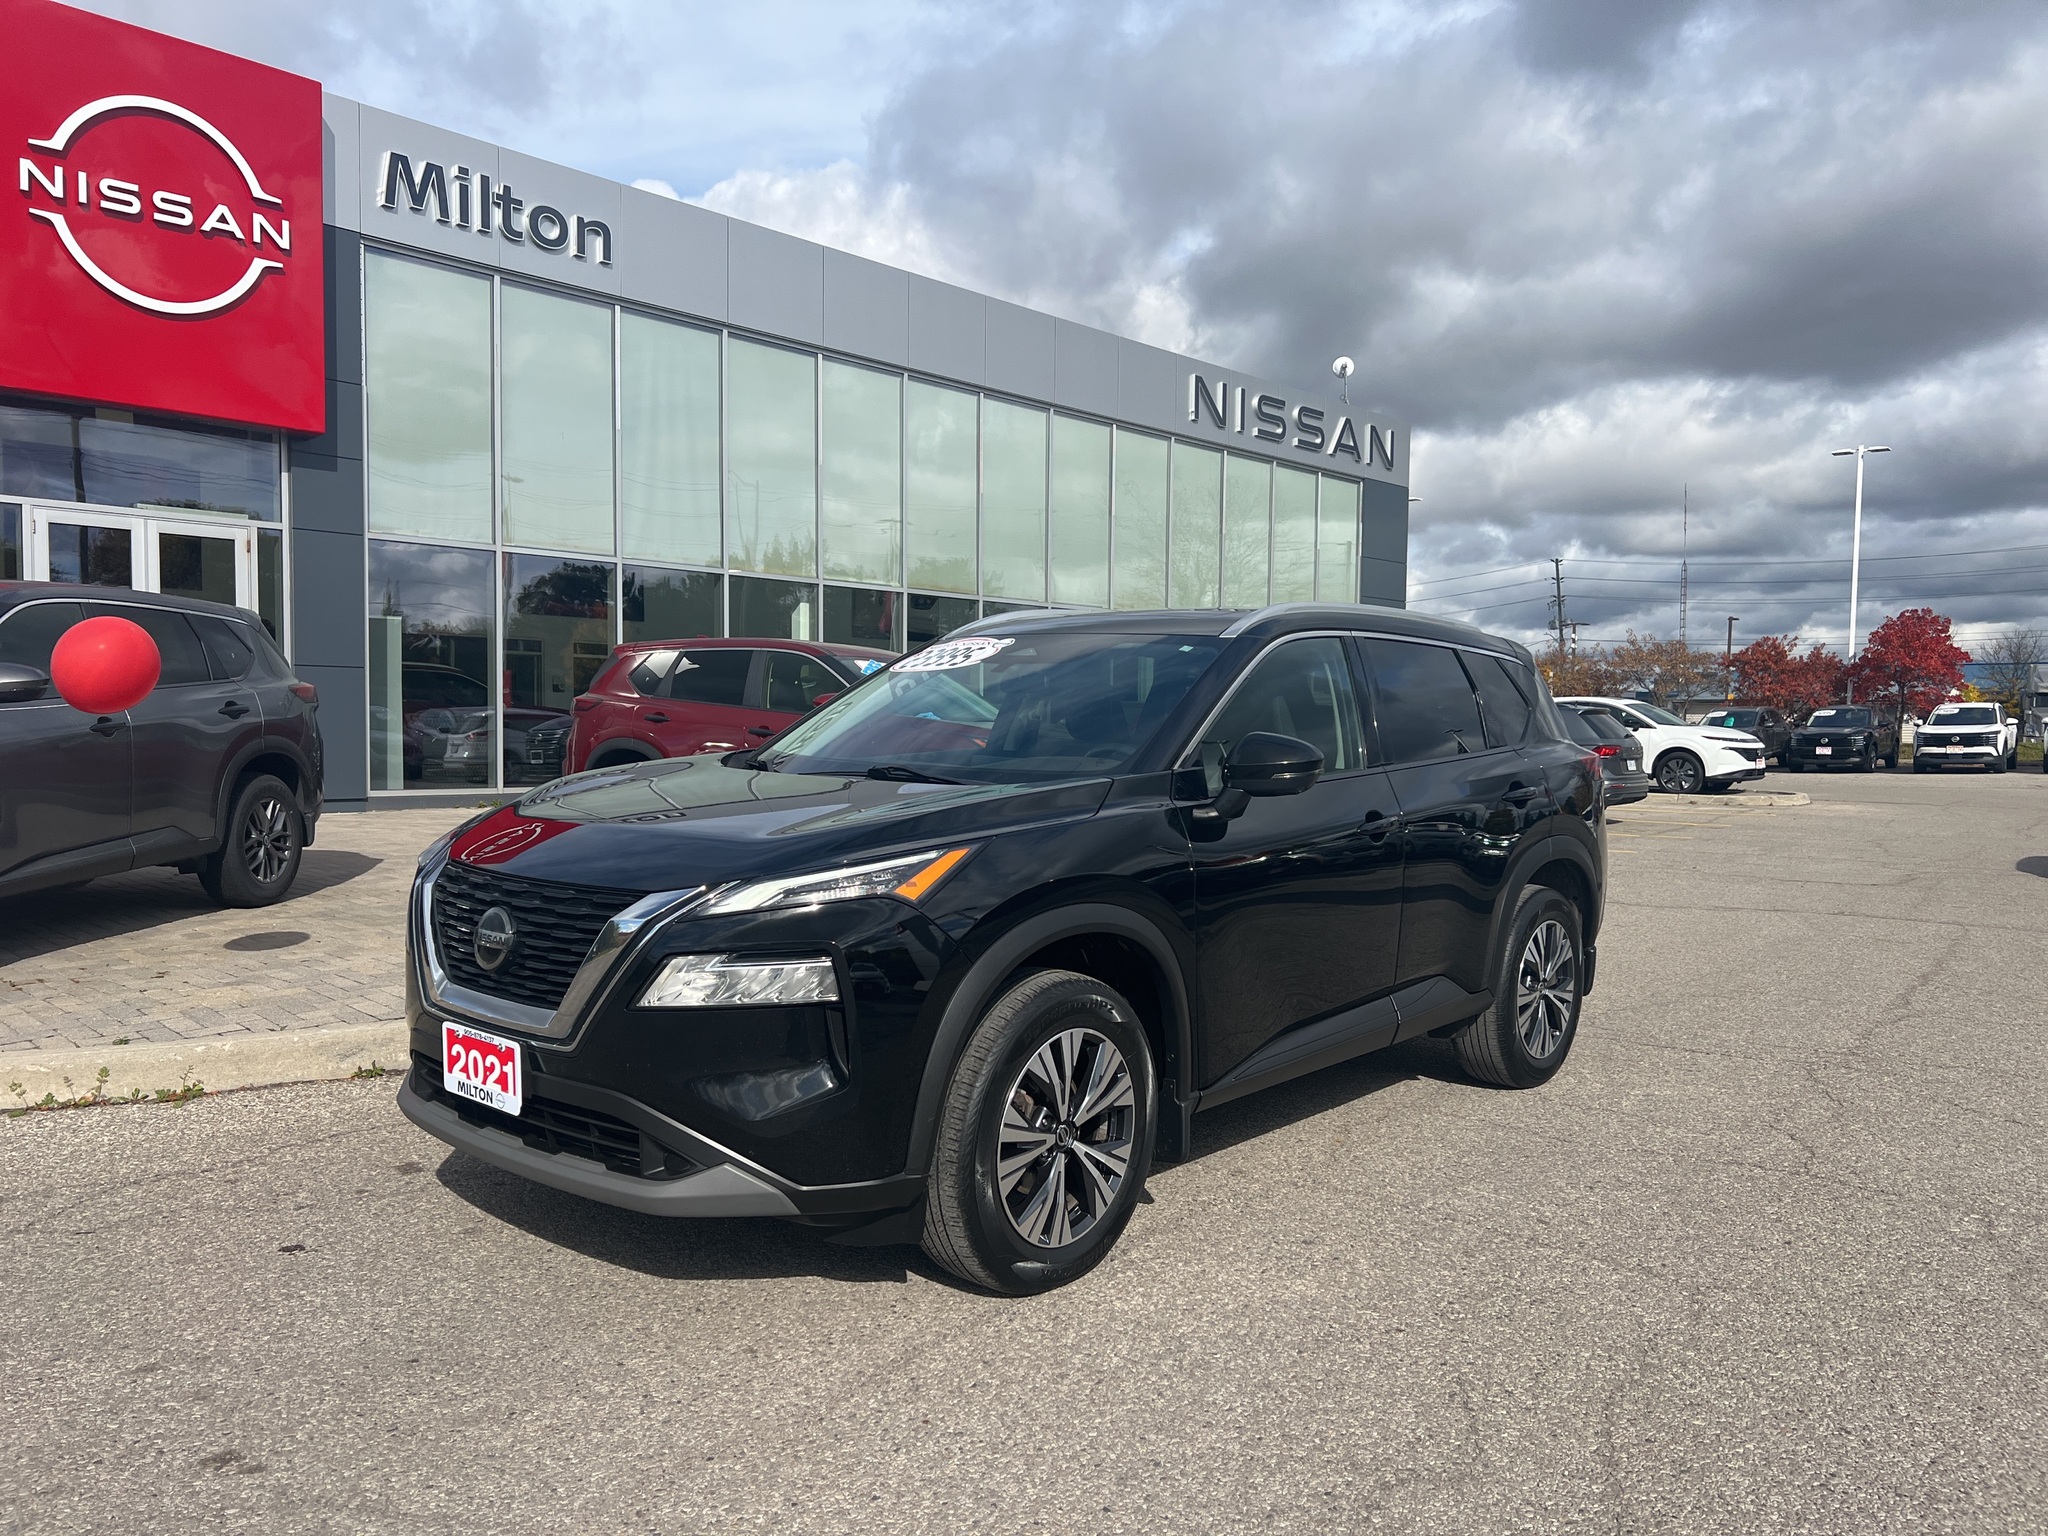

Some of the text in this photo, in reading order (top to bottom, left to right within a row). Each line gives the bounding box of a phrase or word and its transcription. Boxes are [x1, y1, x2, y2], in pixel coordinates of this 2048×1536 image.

[19, 157, 290, 250] NISSAN
[380, 150, 613, 265] Milton
[1188, 373, 1395, 470] NISSAN
[451, 1043, 514, 1097] 2021
[457, 1080, 493, 1105] MILTON
